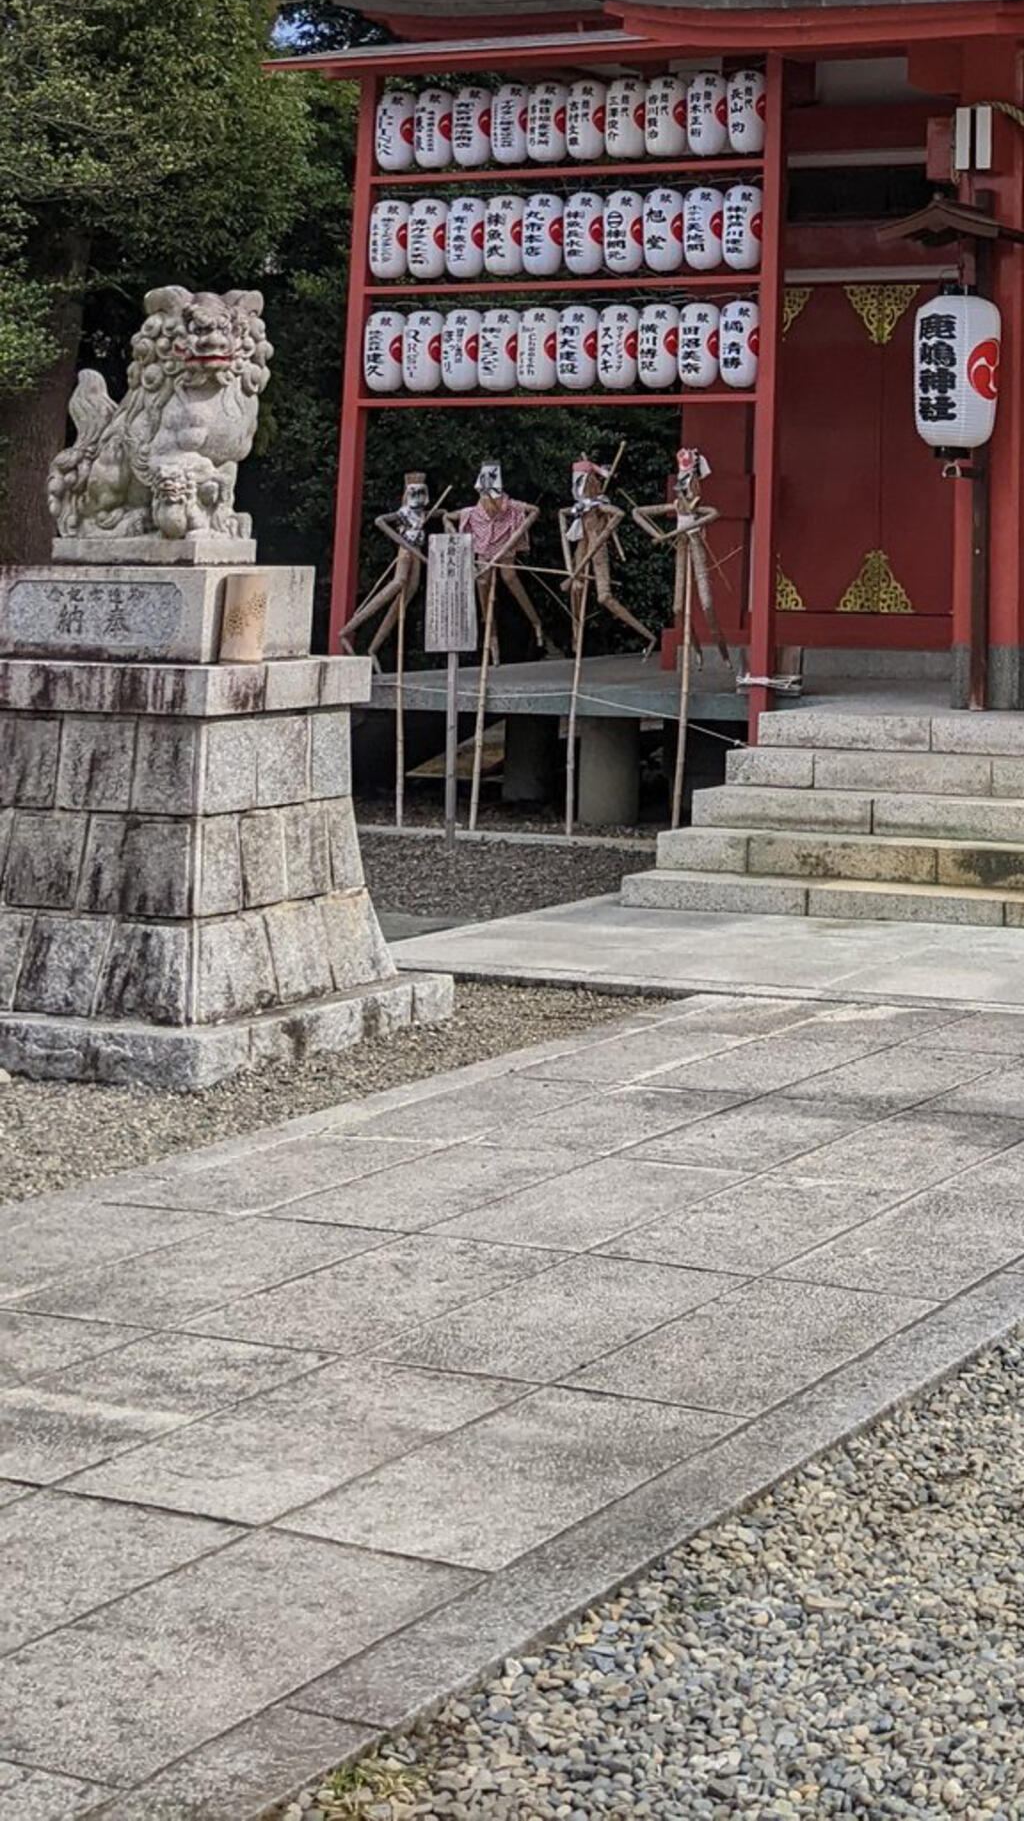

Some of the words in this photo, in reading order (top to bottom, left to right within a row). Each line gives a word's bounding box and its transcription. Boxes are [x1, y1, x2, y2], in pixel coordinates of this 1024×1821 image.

[601, 327, 613, 373] スズキ
[919, 313, 957, 422] 鹿嶋神社
[57, 604, 131, 636] 奉納
